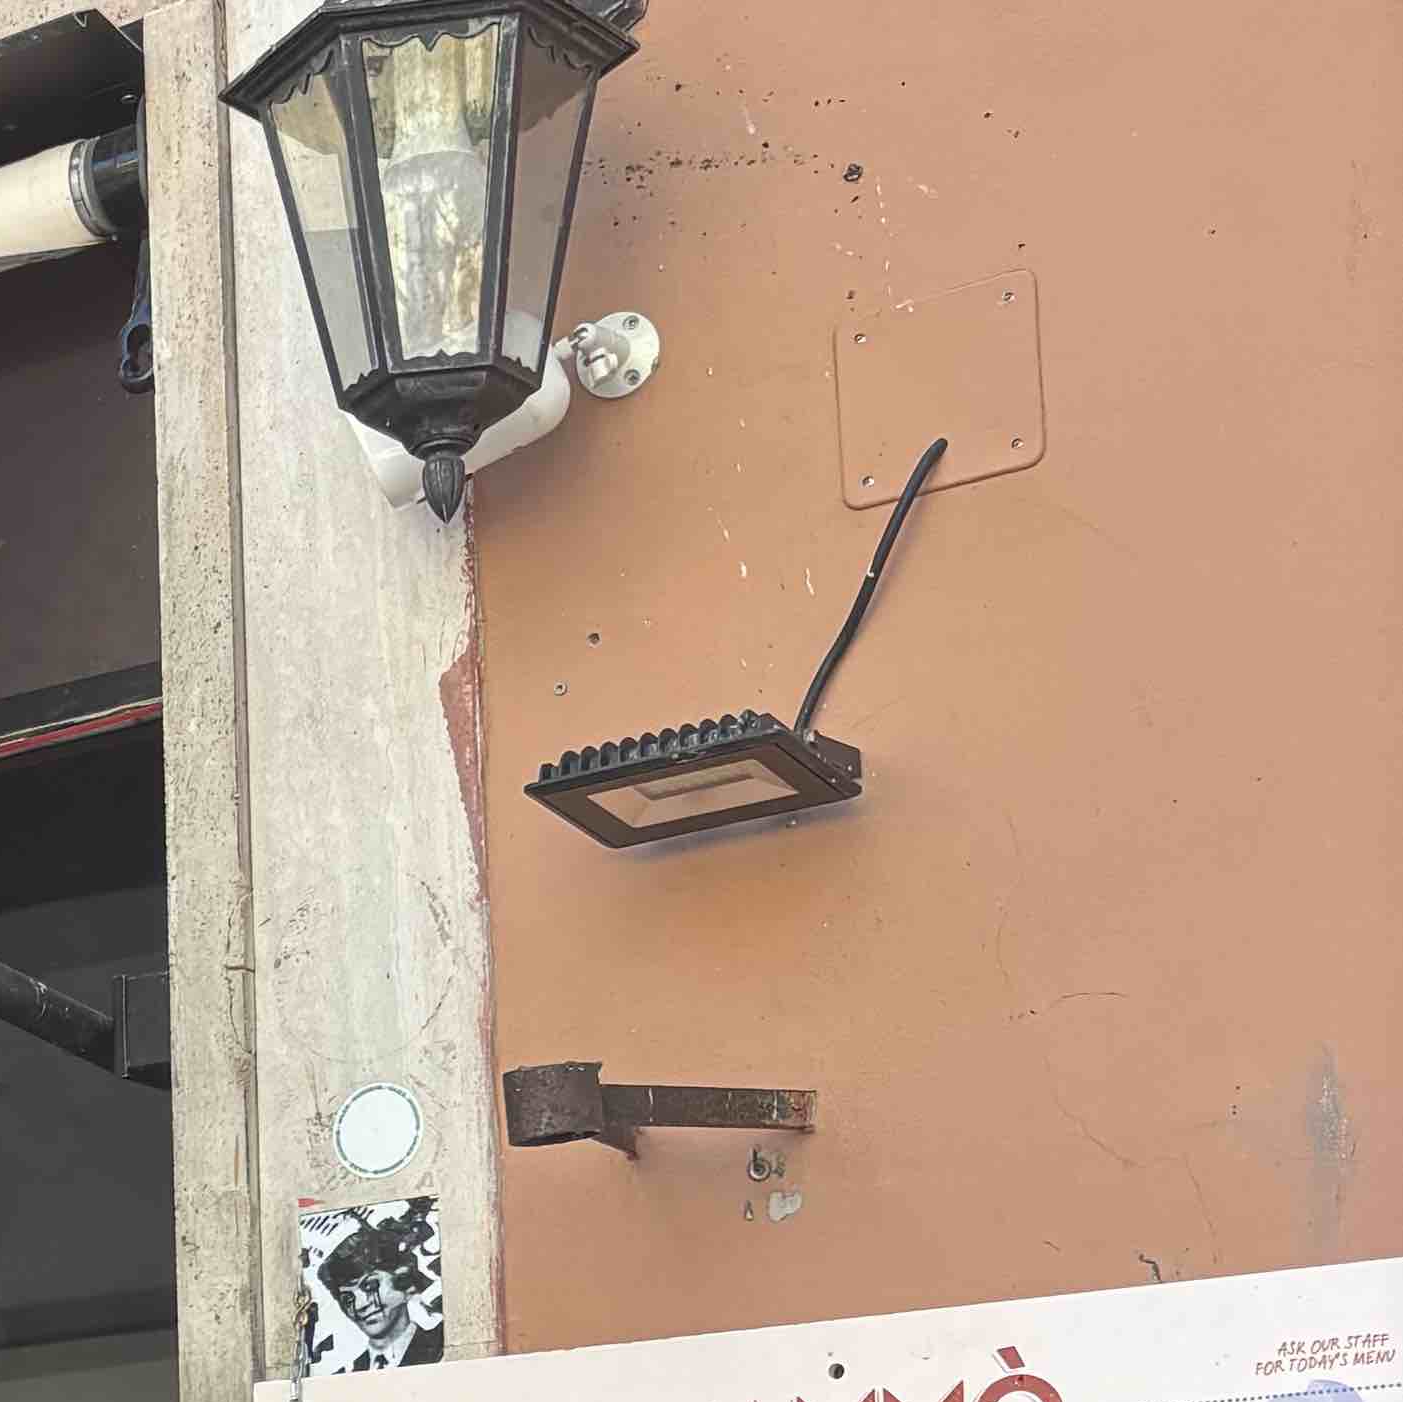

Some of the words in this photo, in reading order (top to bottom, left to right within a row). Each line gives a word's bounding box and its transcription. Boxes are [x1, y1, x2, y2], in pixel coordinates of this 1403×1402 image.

[1278, 1341, 1307, 1357] ASK
[1310, 1338, 1340, 1354] OUR
[1345, 1333, 1390, 1349] STAFF
[1255, 1360, 1285, 1376] FOR
[1289, 1352, 1348, 1372] TODAY'S
[1353, 1349, 1396, 1366] MENU
